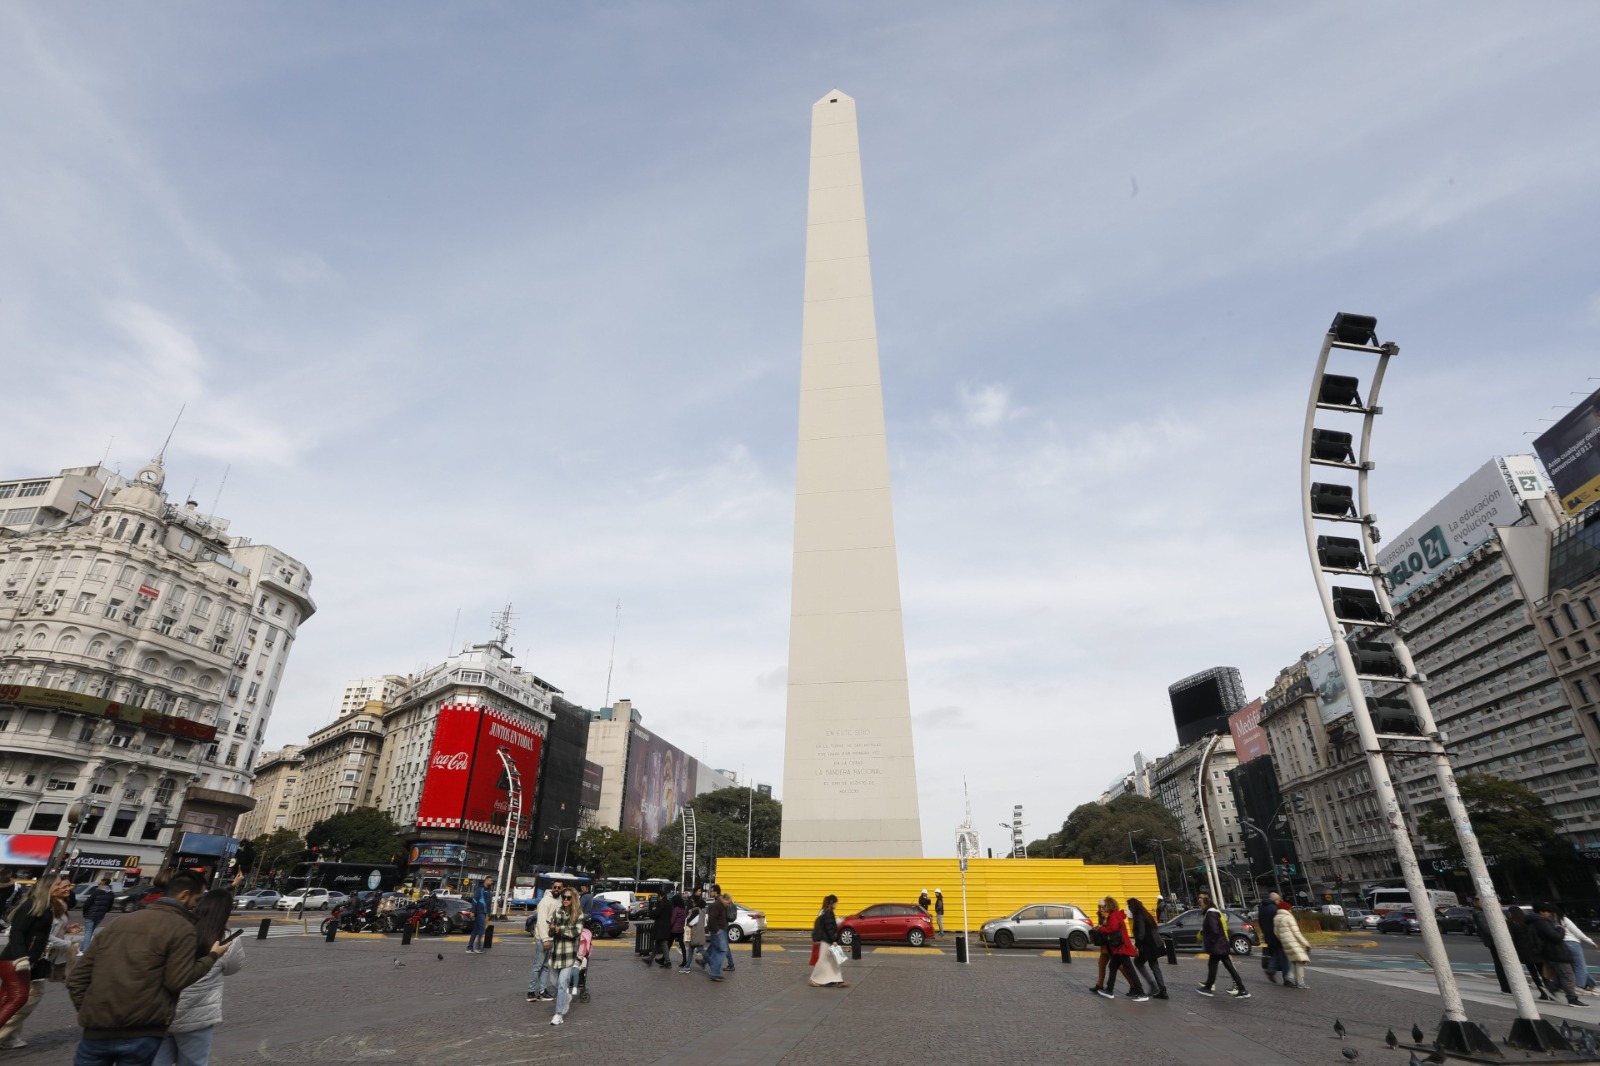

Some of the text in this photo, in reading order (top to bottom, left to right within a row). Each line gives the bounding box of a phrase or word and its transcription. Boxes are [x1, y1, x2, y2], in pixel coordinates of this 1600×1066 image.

[1548, 457, 1561, 470] Ante
[1560, 438, 1585, 460] cualquier
[1575, 450, 1582, 458] al
[1581, 442, 1593, 454] 911
[1447, 489, 1501, 532] La educación
[1453, 507, 1498, 543] evoluciona
[1377, 537, 1415, 567] NIVERSIDAD
[1386, 551, 1423, 590] IGLO
[488, 721, 534, 751] JUNTOS EN TODAS
[430, 750, 469, 770] Coca-Cola
